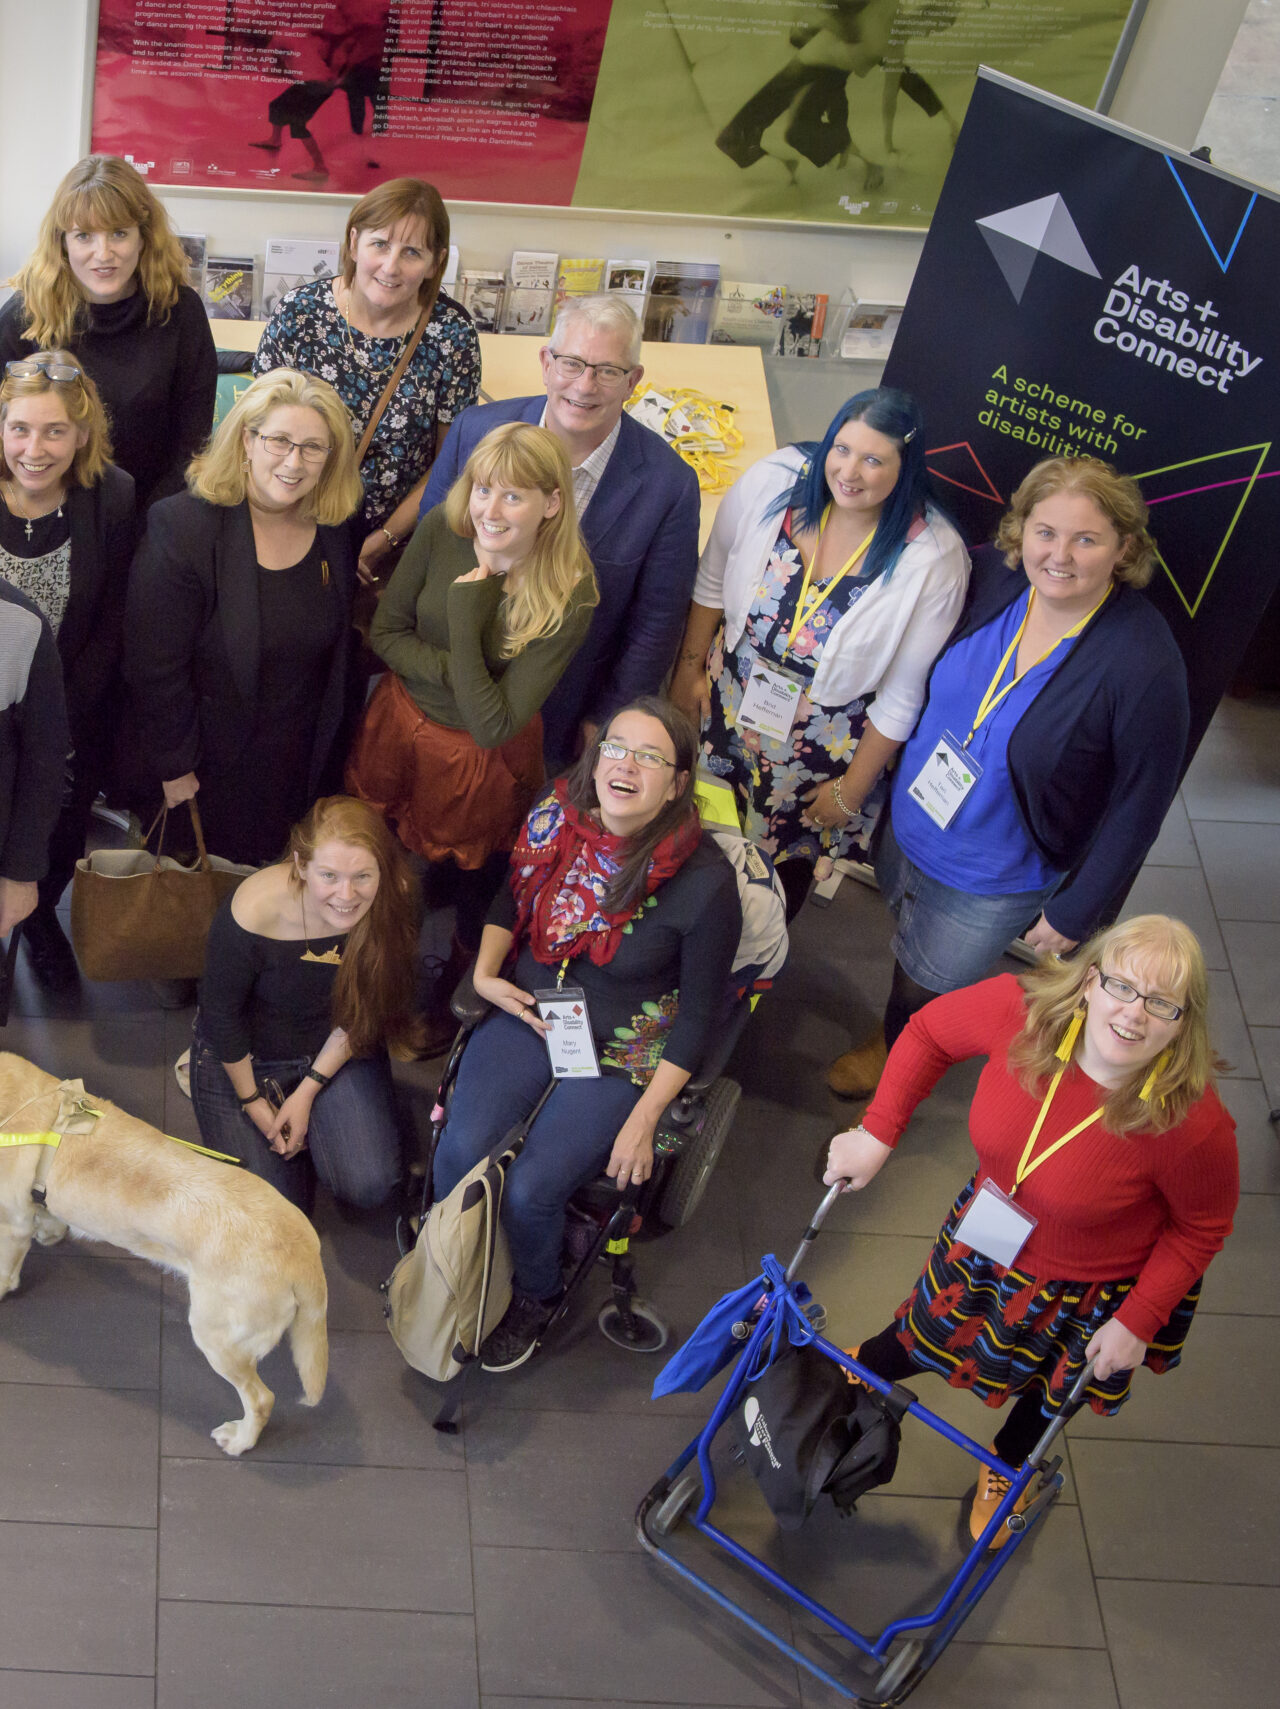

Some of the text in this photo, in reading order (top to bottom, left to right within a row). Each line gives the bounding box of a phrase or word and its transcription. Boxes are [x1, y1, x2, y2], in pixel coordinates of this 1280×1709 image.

[1114, 264, 1190, 312] Arts
[1094, 317, 1234, 394] Connect
[1103, 288, 1263, 377] Disability
[978, 409, 1092, 460] disabiliti
[985, 389, 1119, 454] artists with
[991, 364, 1147, 441] A scheme for
